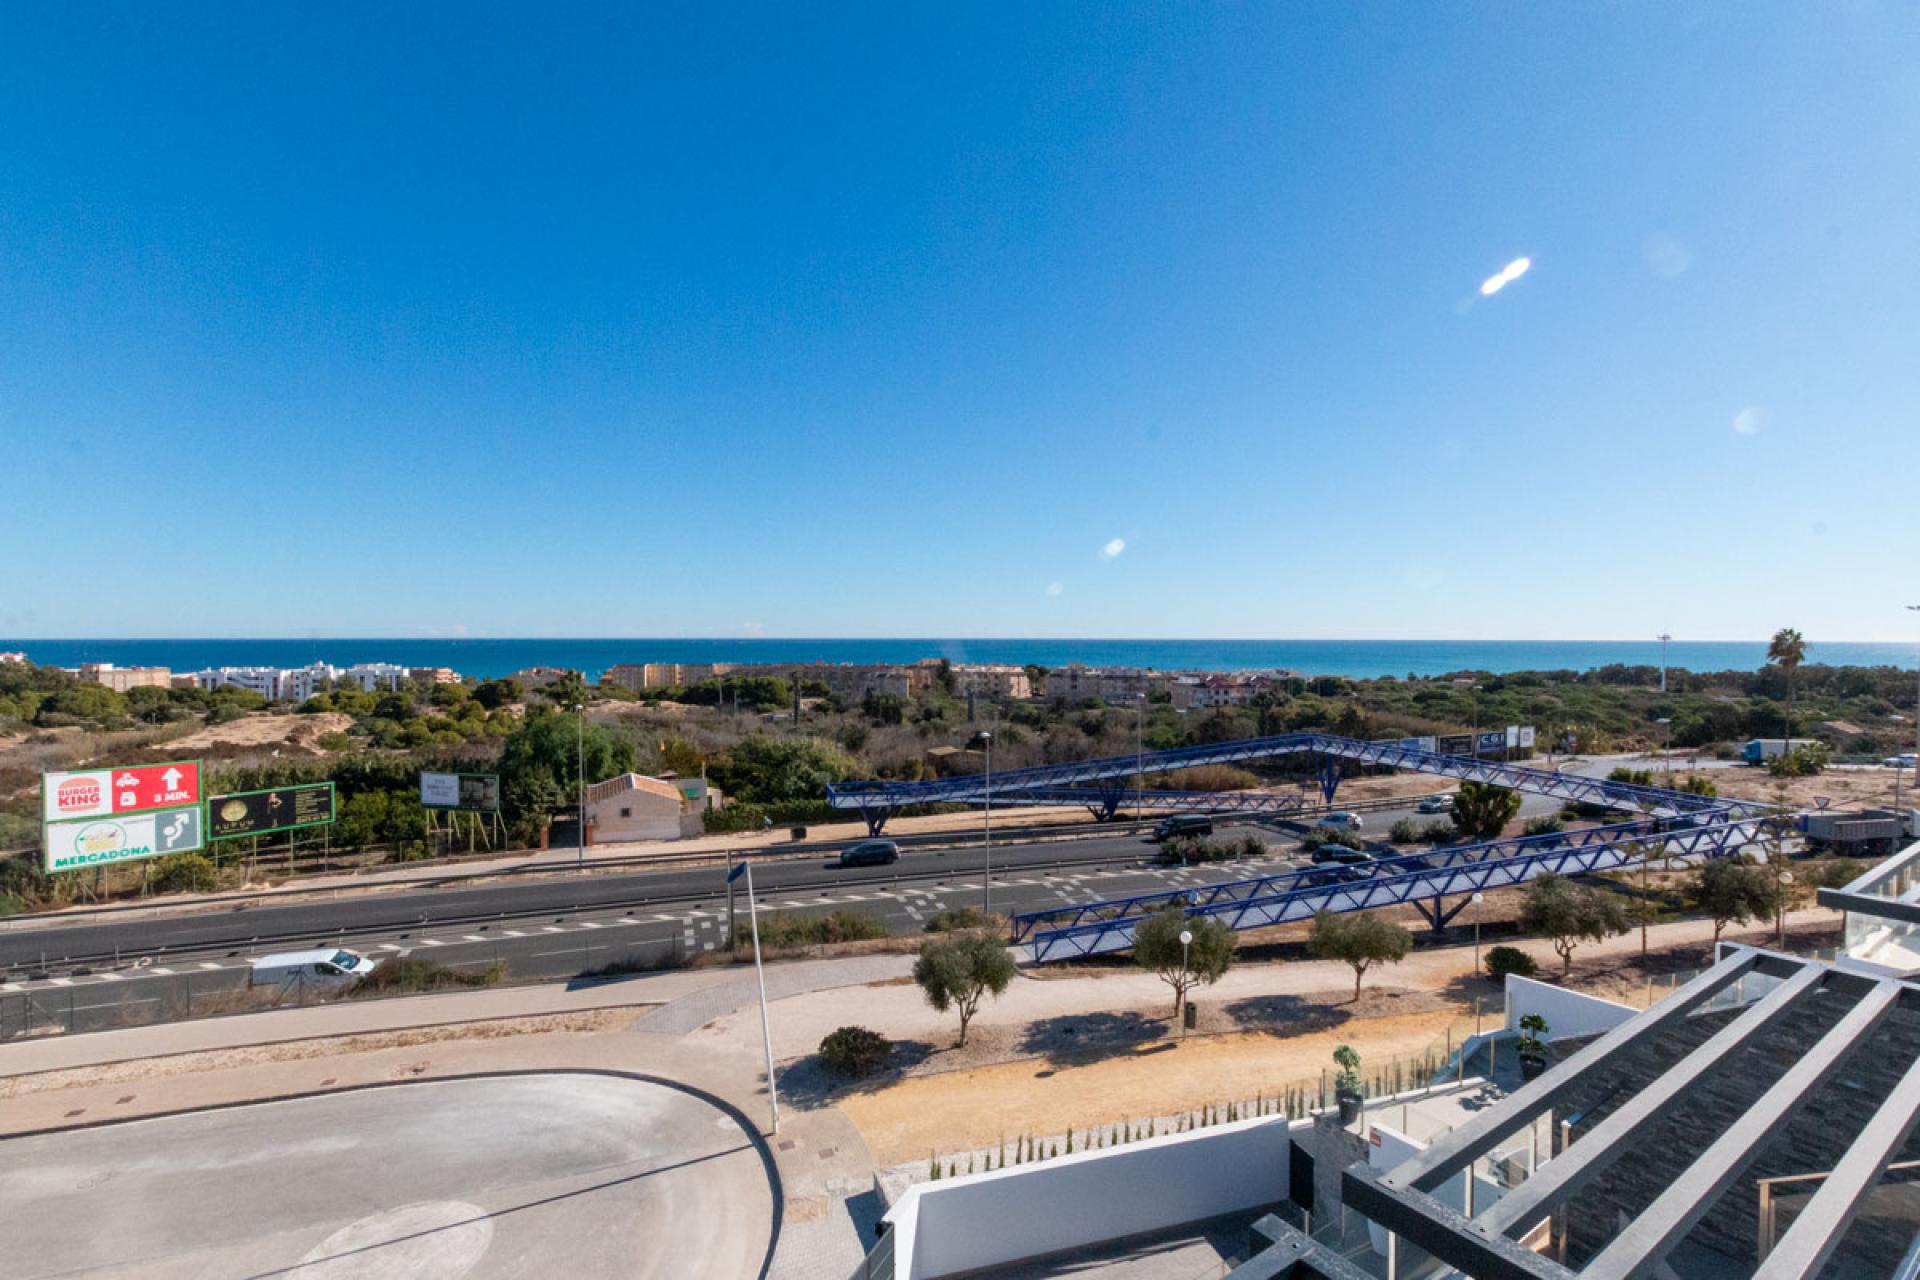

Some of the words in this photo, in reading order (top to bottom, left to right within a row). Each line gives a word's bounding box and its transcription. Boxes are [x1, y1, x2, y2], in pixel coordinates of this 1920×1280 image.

[58, 787, 100, 798] BURGER
[164, 791, 191, 801] MIN.
[58, 794, 101, 807] KING
[55, 846, 151, 867] MERCADONA
